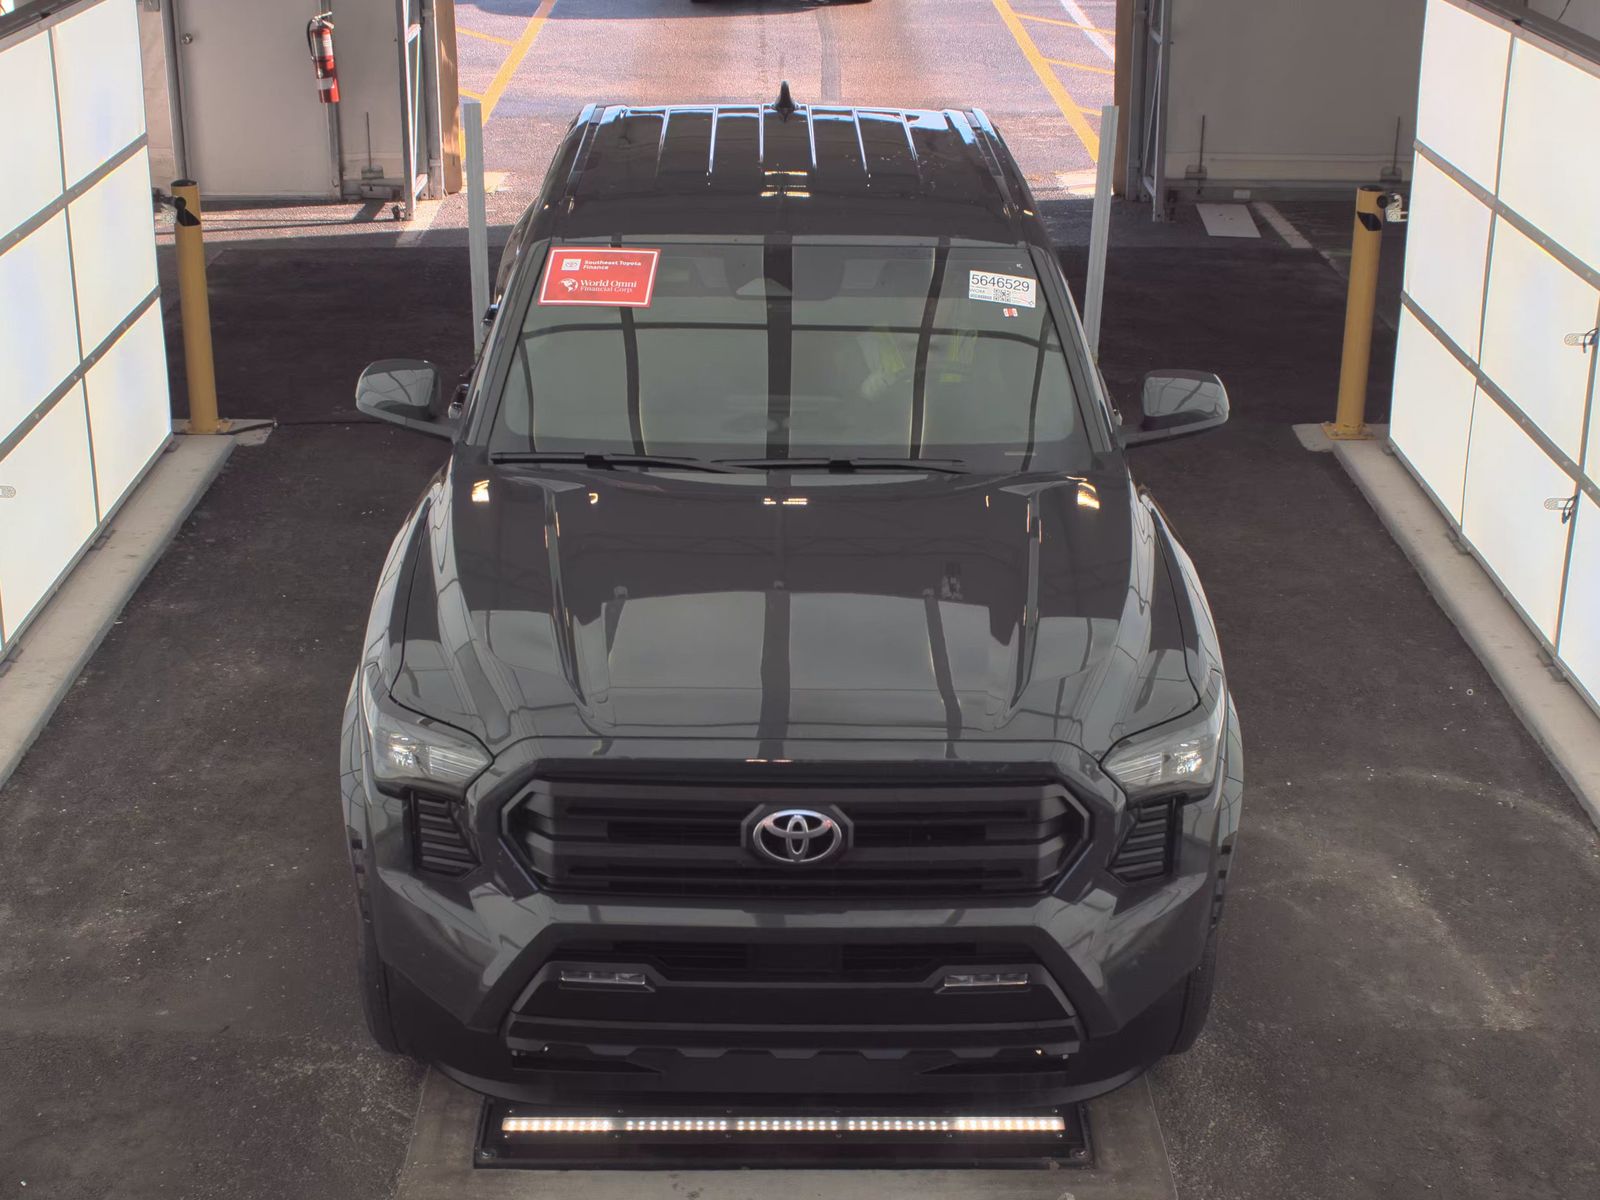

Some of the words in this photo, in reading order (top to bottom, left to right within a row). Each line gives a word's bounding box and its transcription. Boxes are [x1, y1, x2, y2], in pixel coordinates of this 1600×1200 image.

[581, 279, 609, 287] World
[610, 280, 637, 288] Omni
[972, 274, 1029, 292] 5646529
